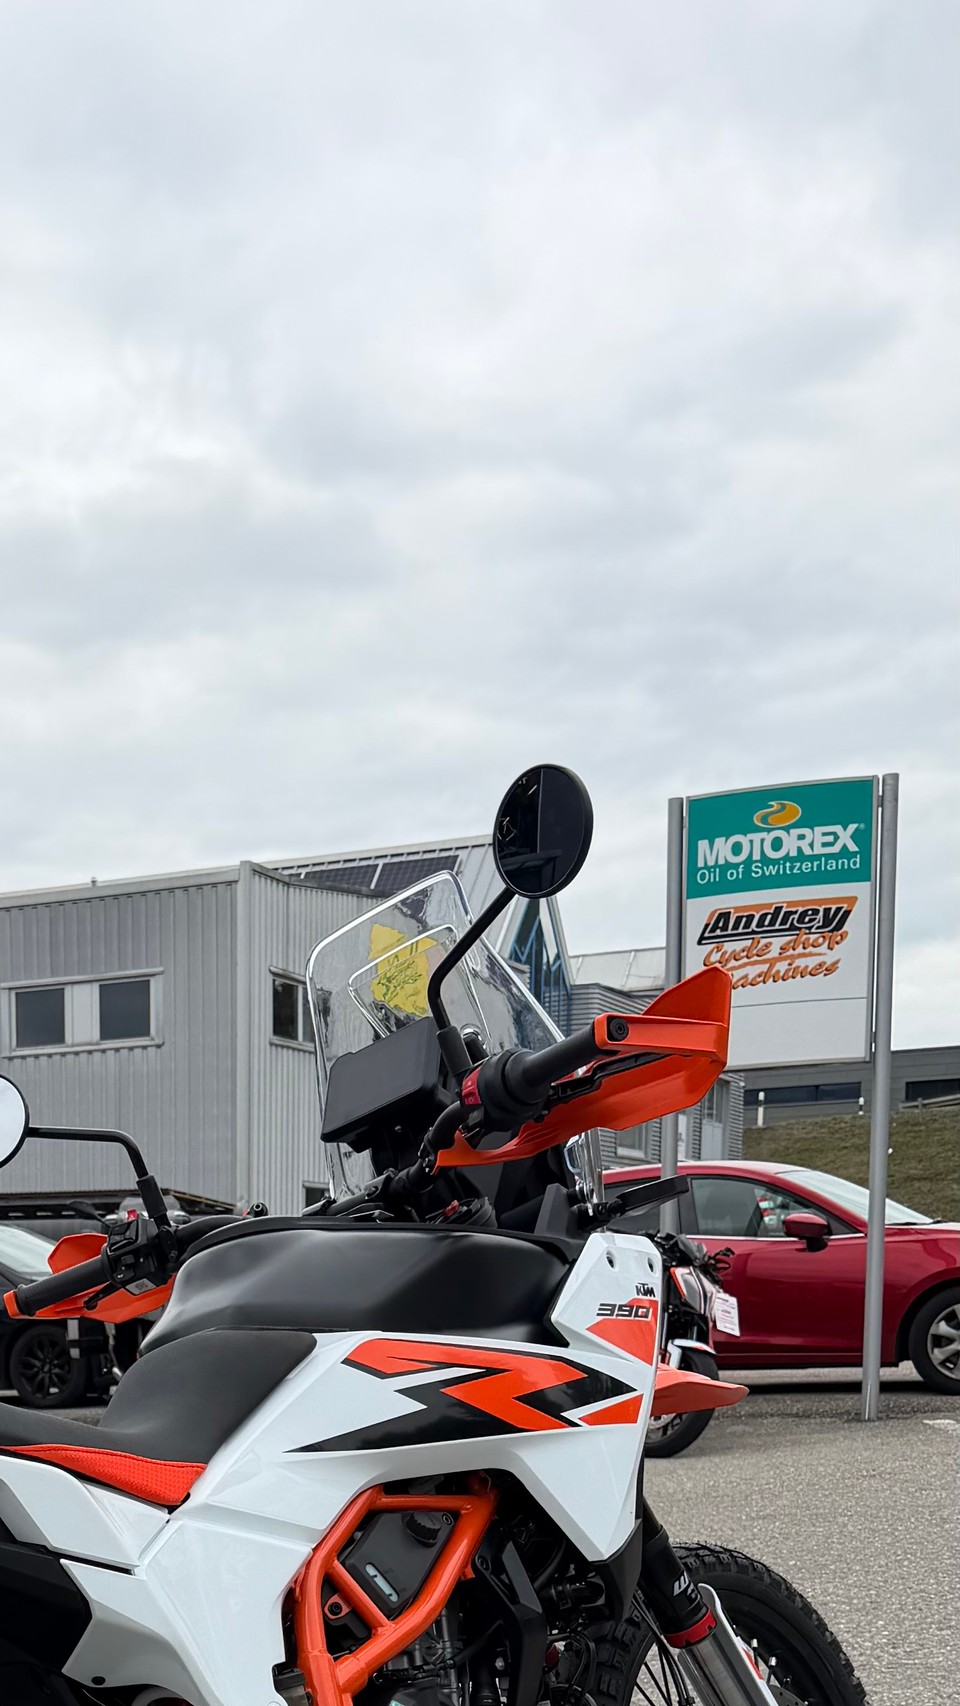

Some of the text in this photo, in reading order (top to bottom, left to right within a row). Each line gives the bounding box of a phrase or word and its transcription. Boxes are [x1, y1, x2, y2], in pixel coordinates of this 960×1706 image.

[697, 823, 859, 867] MOTOREX
[697, 854, 861, 885] Oil of Switzerland
[707, 904, 846, 934] Andrey
[703, 929, 849, 968] Cycle shop
[730, 957, 841, 990] achines
[635, 1282, 656, 1298] KTM
[596, 1302, 652, 1319] 390
